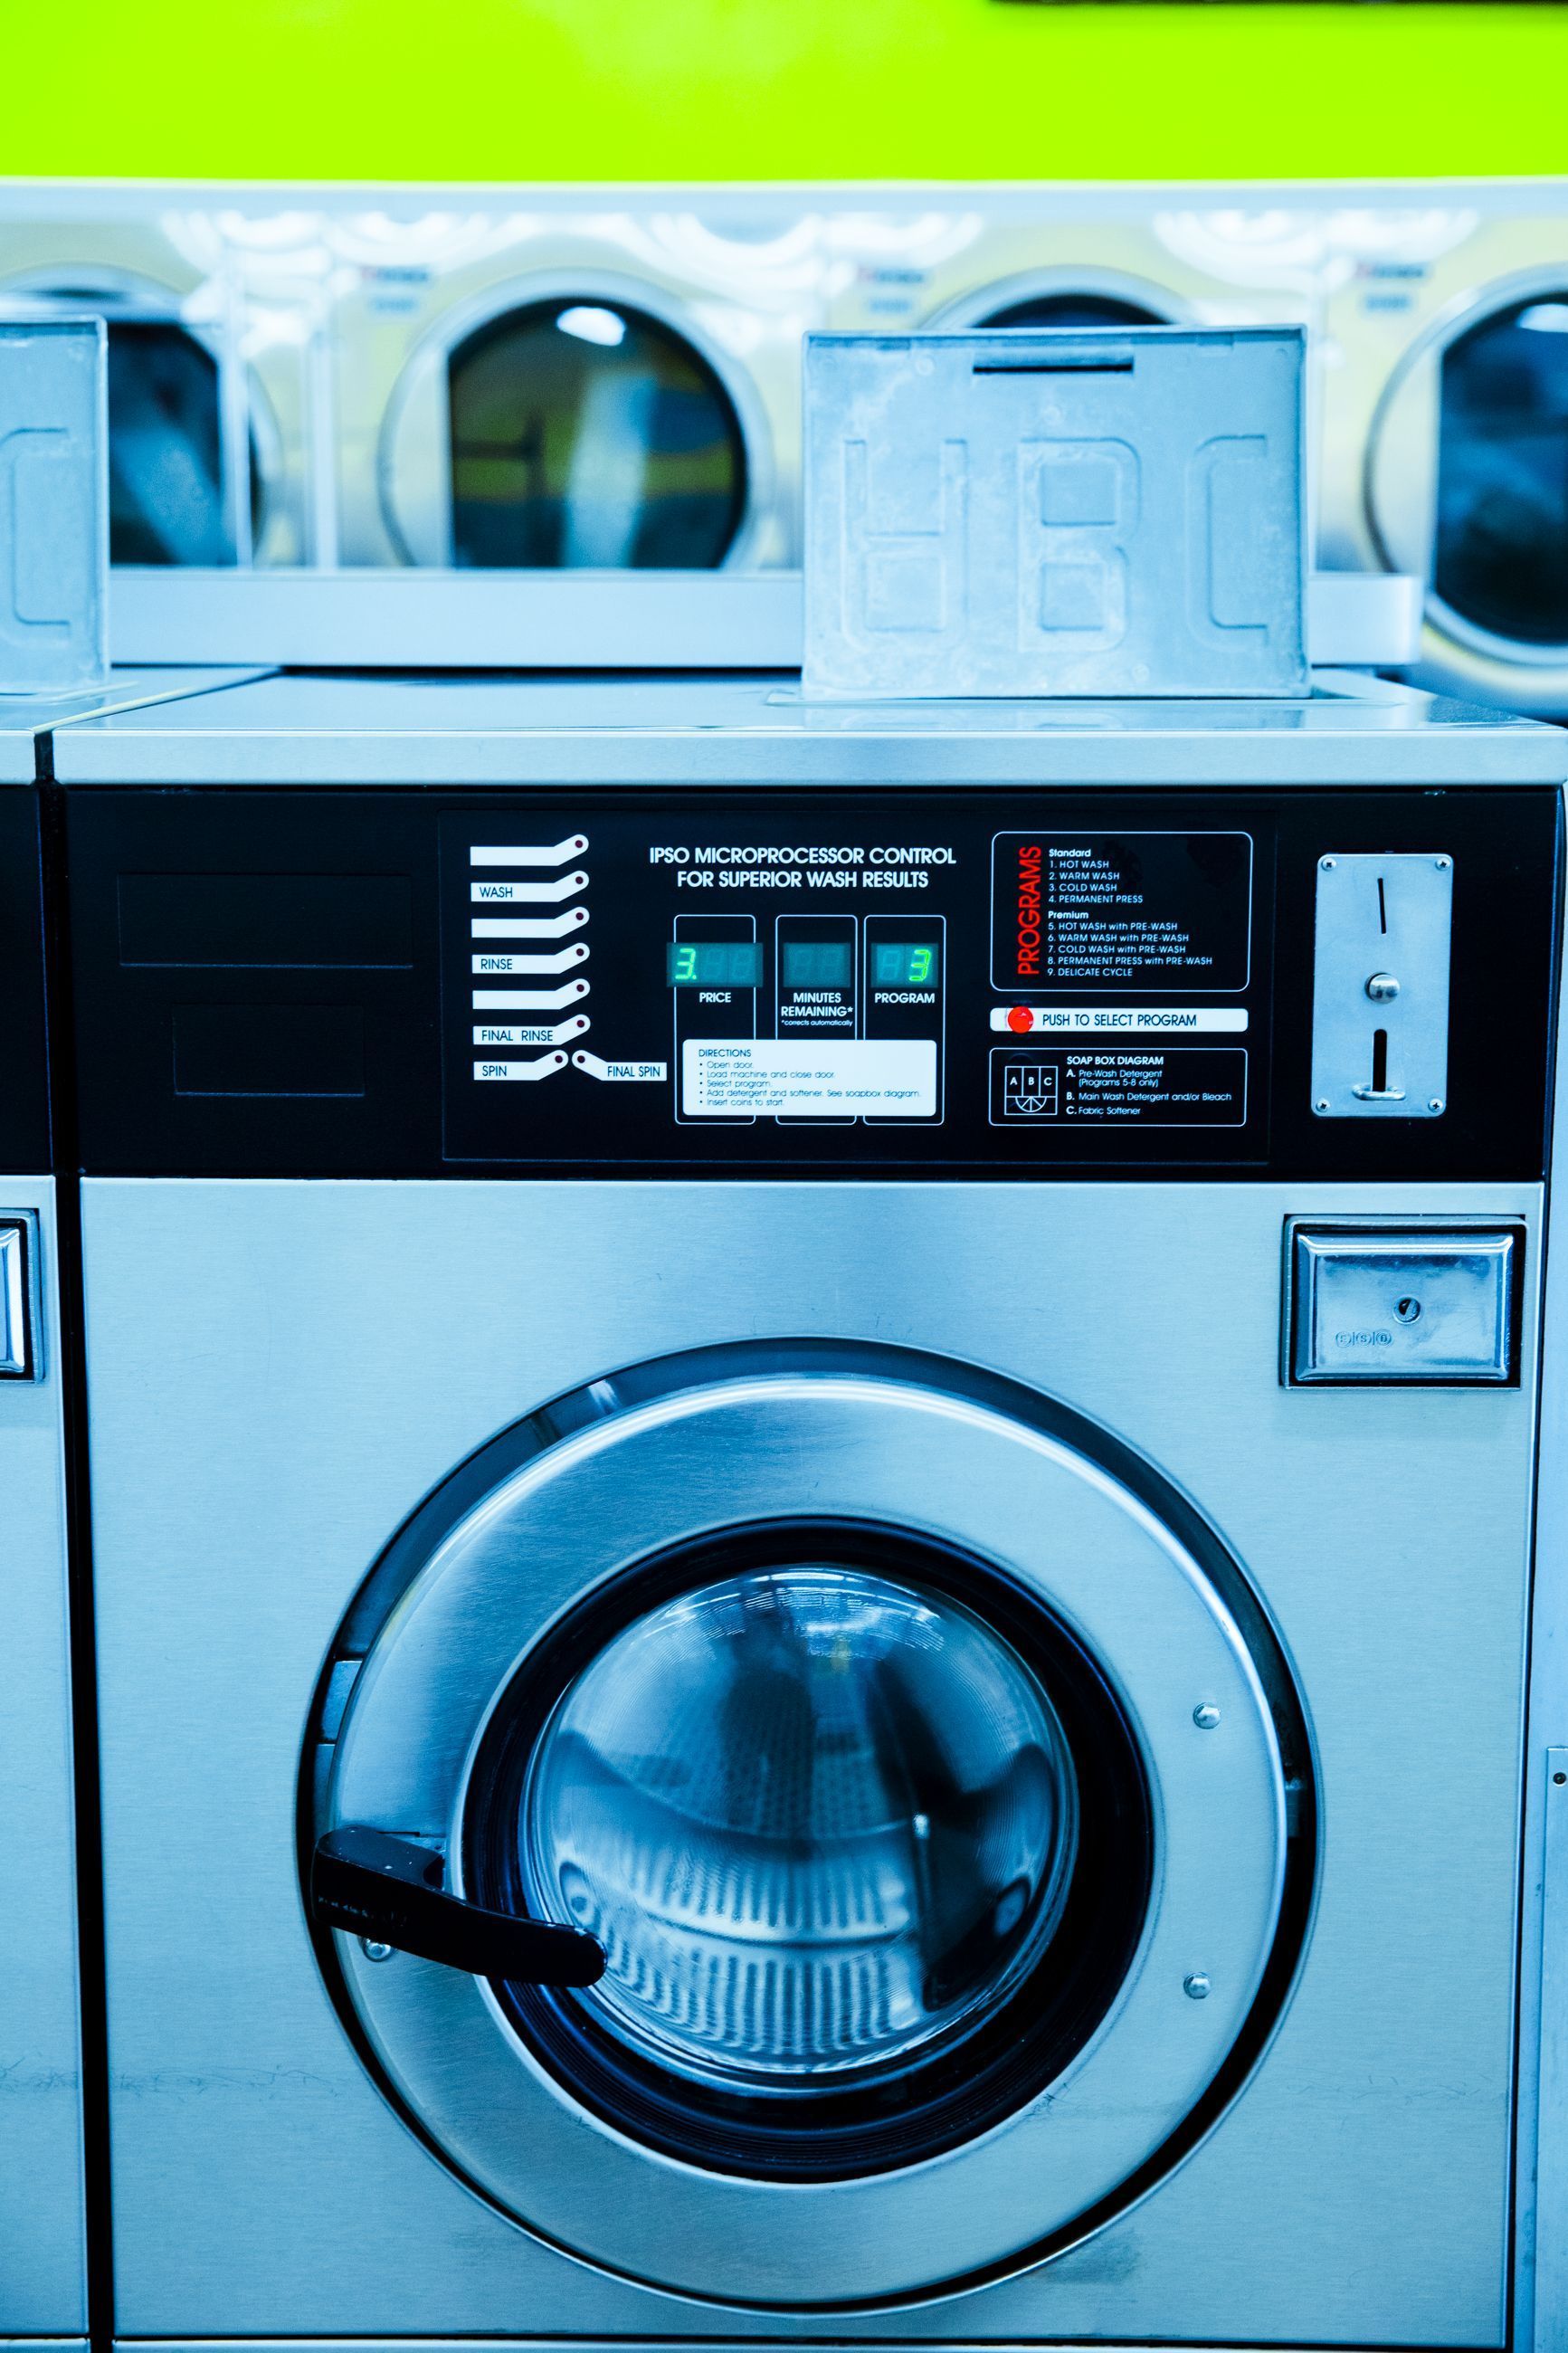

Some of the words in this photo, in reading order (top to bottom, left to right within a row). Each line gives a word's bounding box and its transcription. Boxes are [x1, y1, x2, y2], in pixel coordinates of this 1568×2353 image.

[650, 847, 689, 863] IPSO
[695, 847, 864, 863] MICROPROCESSOR
[870, 847, 956, 864] CONTROL
[1049, 849, 1091, 857] Standard
[1081, 861, 1109, 869] WASH
[678, 871, 714, 887] FOR
[718, 871, 802, 887] SUPERIOR
[806, 872, 857, 887] WASH
[862, 872, 928, 888] RESULTS
[1059, 883, 1088, 891] COLD
[1089, 883, 1117, 891] WASH
[480, 887, 512, 898] WASH
[1060, 895, 1114, 903] PERMANENT
[1116, 895, 1143, 903] PRESS
[1017, 846, 1041, 975] PROGRAMS
[1048, 910, 1088, 919] Premium
[1059, 922, 1077, 930] HOT
[1079, 922, 1106, 930] WASH
[1130, 922, 1177, 930] PRE-WASH
[1090, 934, 1117, 942] WASH
[1142, 934, 1189, 942] PRE-WASH
[1059, 945, 1086, 953] COLD
[1088, 945, 1115, 953] WASH
[481, 958, 512, 969] RINSE
[908, 948, 932, 982] 3
[1058, 957, 1113, 965] PERMANENT
[1116, 957, 1143, 965] PRESS
[1166, 957, 1212, 965] PRE-WASH
[1102, 968, 1133, 976] CYCLE
[699, 992, 731, 1003] PRICE
[794, 993, 841, 1003] MINUTES
[875, 993, 935, 1003] PROGRAM
[1043, 1015, 1069, 1025] PUSH
[1075, 1015, 1089, 1025] TO
[1095, 1015, 1133, 1026] SELECT
[1137, 1015, 1196, 1025] PROGRAM
[482, 1030, 513, 1041] FINAL
[522, 1030, 553, 1041] RINSE
[698, 1049, 751, 1057] DIRECTIONS
[707, 1061, 730, 1069] Open
[1067, 1056, 1093, 1064] SOAP
[1095, 1056, 1116, 1064] BOX
[1117, 1056, 1164, 1065] DIAGRAM
[482, 1065, 507, 1076] SPIN
[608, 1066, 635, 1077] FINAL
[639, 1066, 660, 1077] SPIN
[707, 1071, 727, 1079] Load
[730, 1071, 768, 1079] machine
[770, 1071, 787, 1079] and
[790, 1071, 813, 1079] close
[1079, 1070, 1117, 1078] Pre-Wash
[1119, 1070, 1163, 1080] Detergent
[707, 1080, 732, 1088] Select
[1009, 1076, 1019, 1086] A
[1027, 1076, 1036, 1086] B
[1043, 1076, 1052, 1086] C
[1079, 1079, 1120, 1088] (Programs
[1138, 1079, 1159, 1088] only)
[707, 1089, 724, 1097] Add
[727, 1090, 767, 1098] detergent
[827, 1089, 842, 1098] See
[845, 1090, 880, 1099] soapbox
[1127, 1092, 1169, 1102] Detergent
[707, 1099, 727, 1107] Insert
[755, 1099, 764, 1107] to
